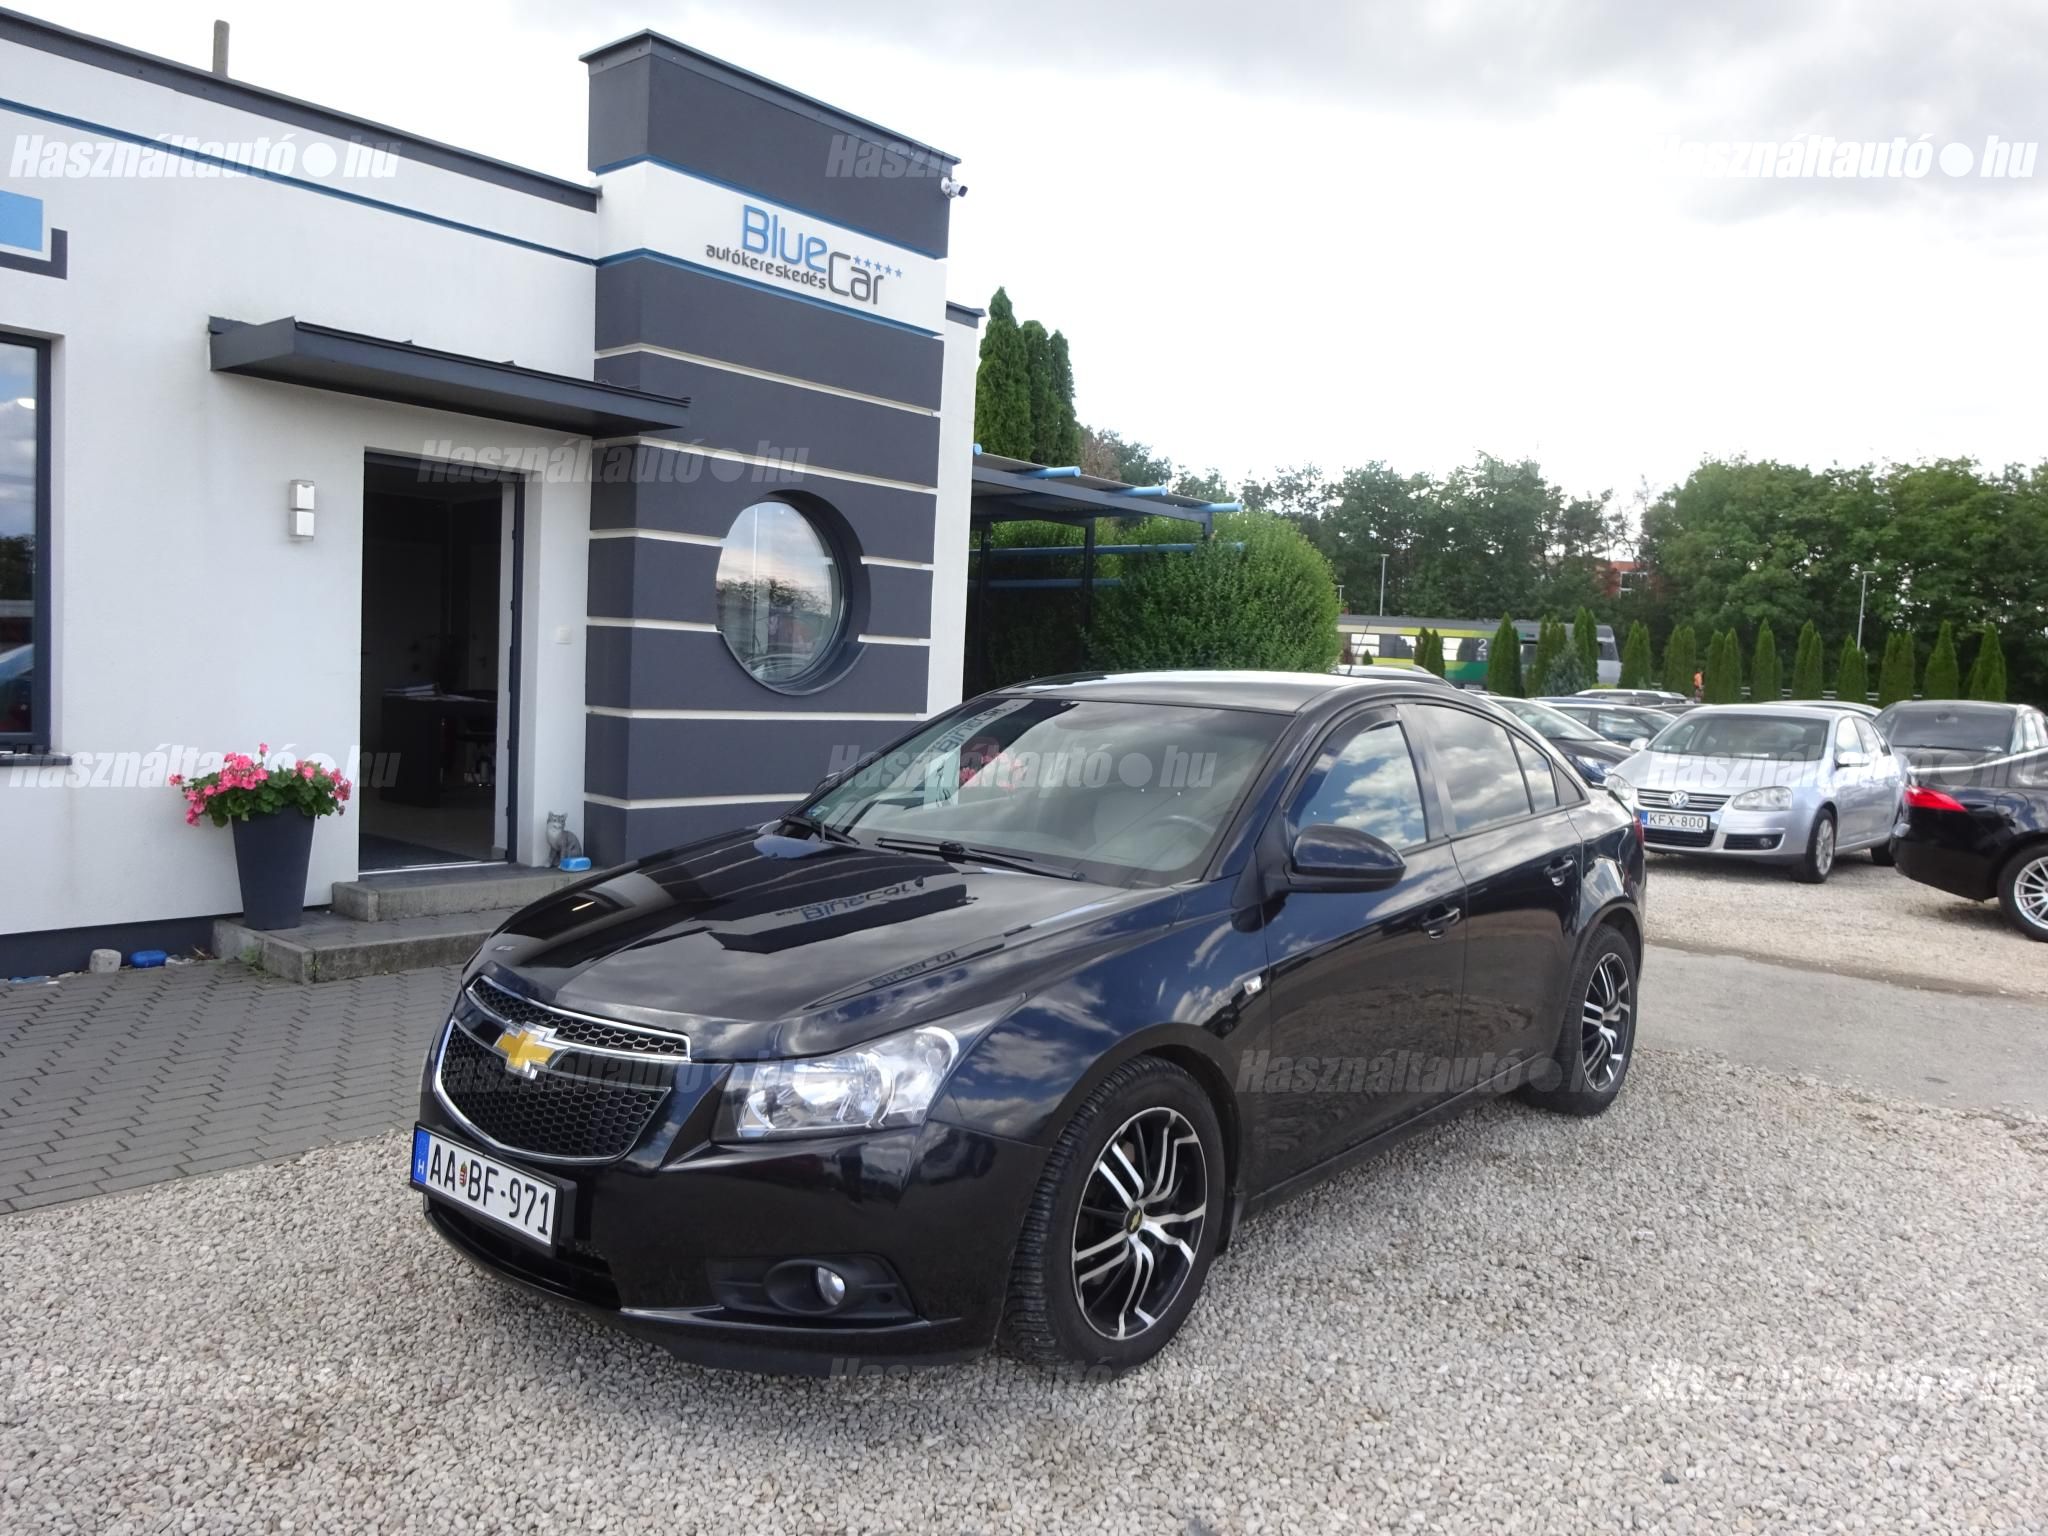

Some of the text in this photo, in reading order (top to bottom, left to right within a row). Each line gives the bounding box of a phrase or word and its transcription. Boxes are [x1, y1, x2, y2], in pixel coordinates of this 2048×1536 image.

[706, 244, 827, 290] autókereskedés
[1477, 638, 1488, 652] 2
[1649, 813, 1705, 829] KFX-800
[417, 1159, 425, 1175] H
